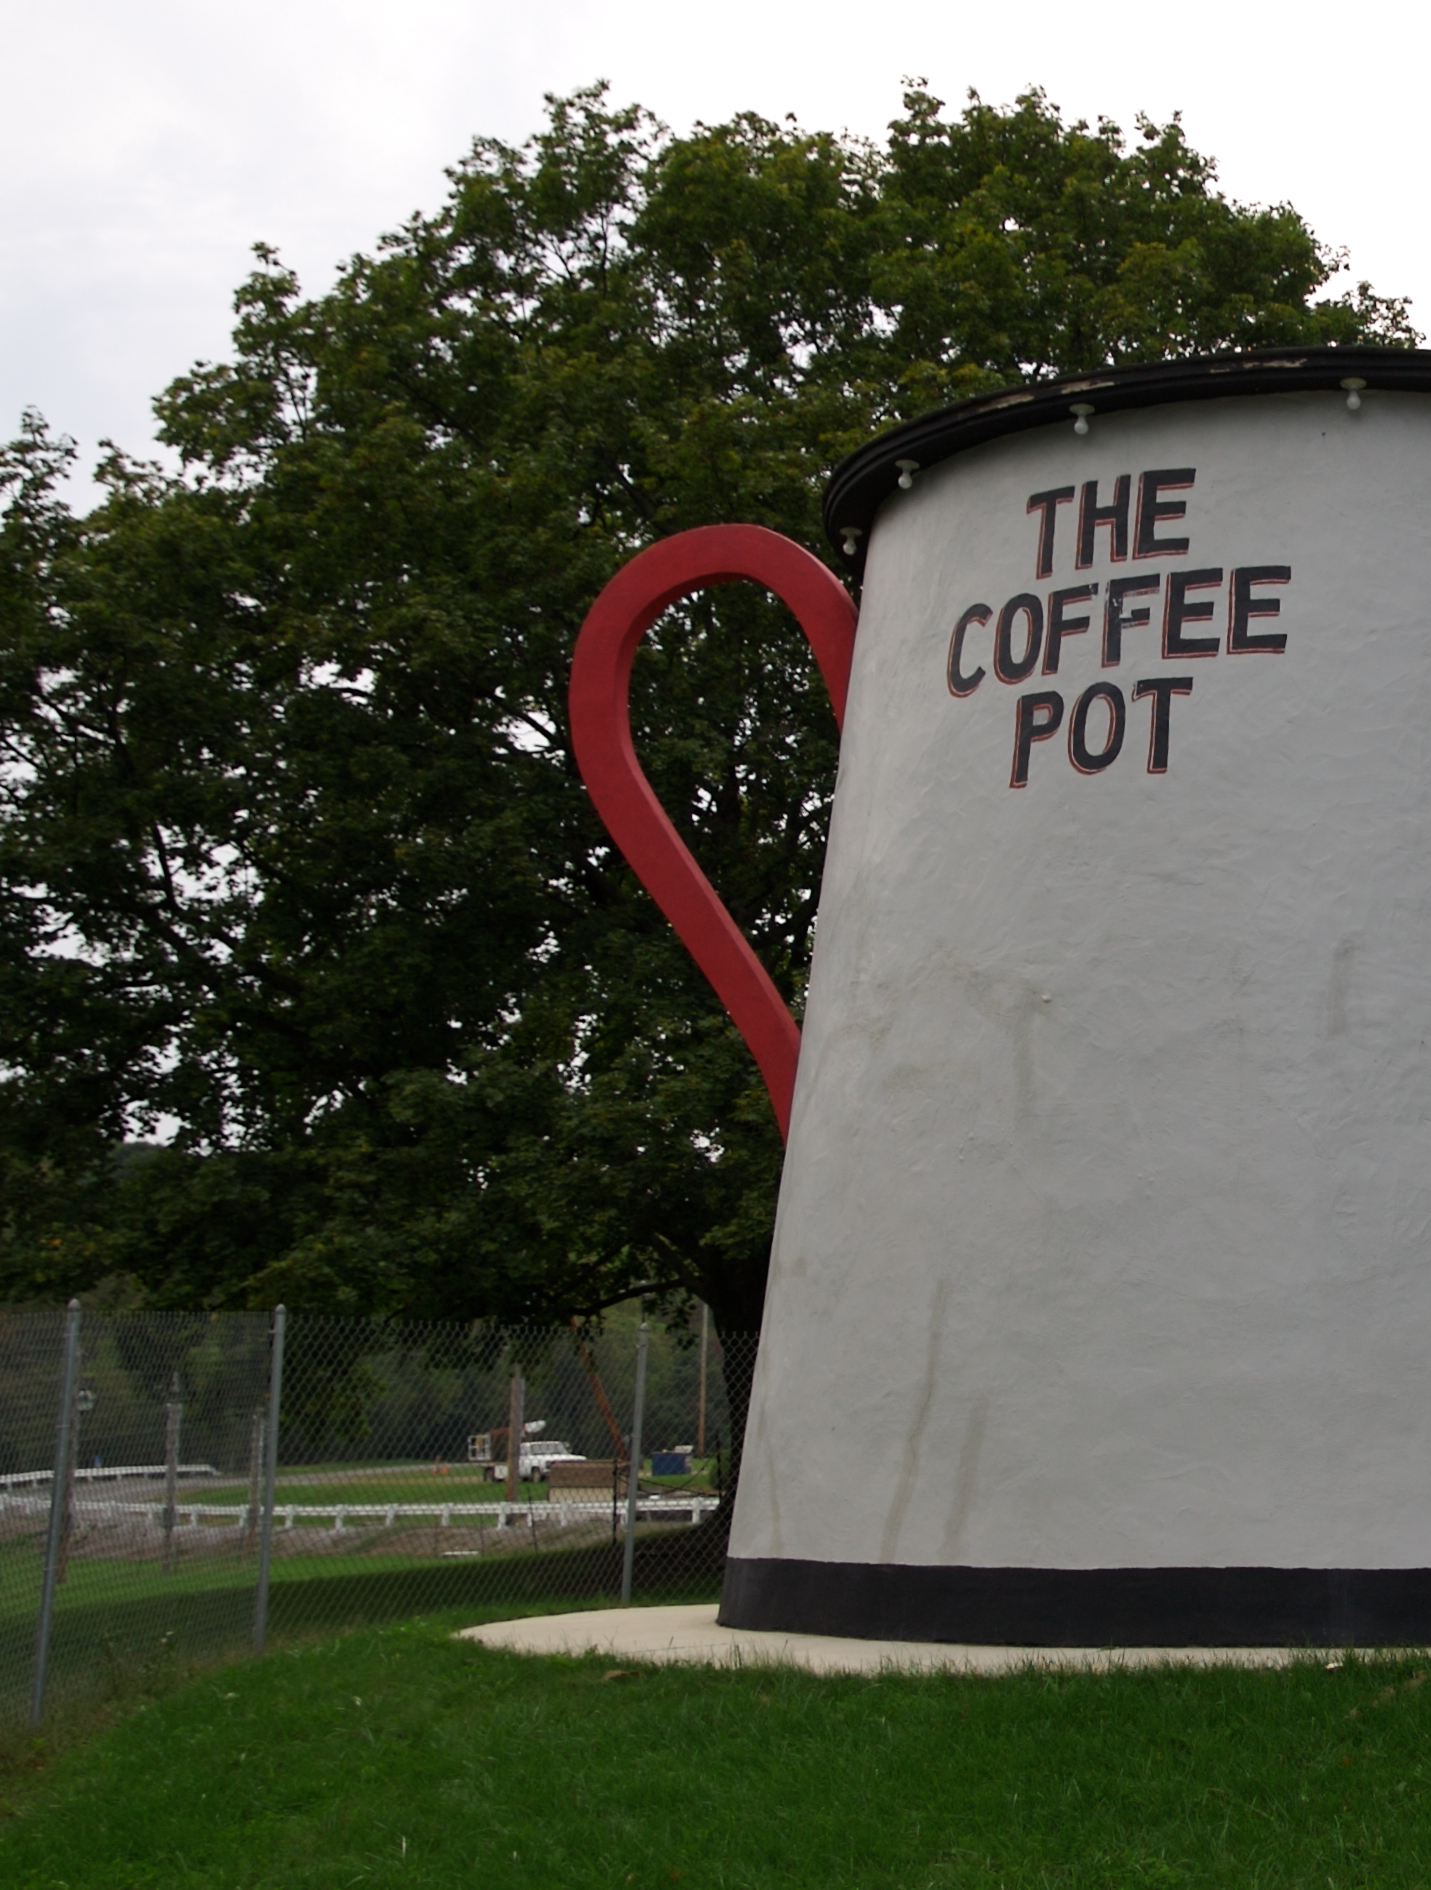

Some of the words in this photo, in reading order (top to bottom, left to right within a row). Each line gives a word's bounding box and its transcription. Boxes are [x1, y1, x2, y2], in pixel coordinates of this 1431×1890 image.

[1026, 468, 1196, 580] THE
[947, 566, 1292, 698] COFFEE
[1008, 677, 1194, 789] POT
